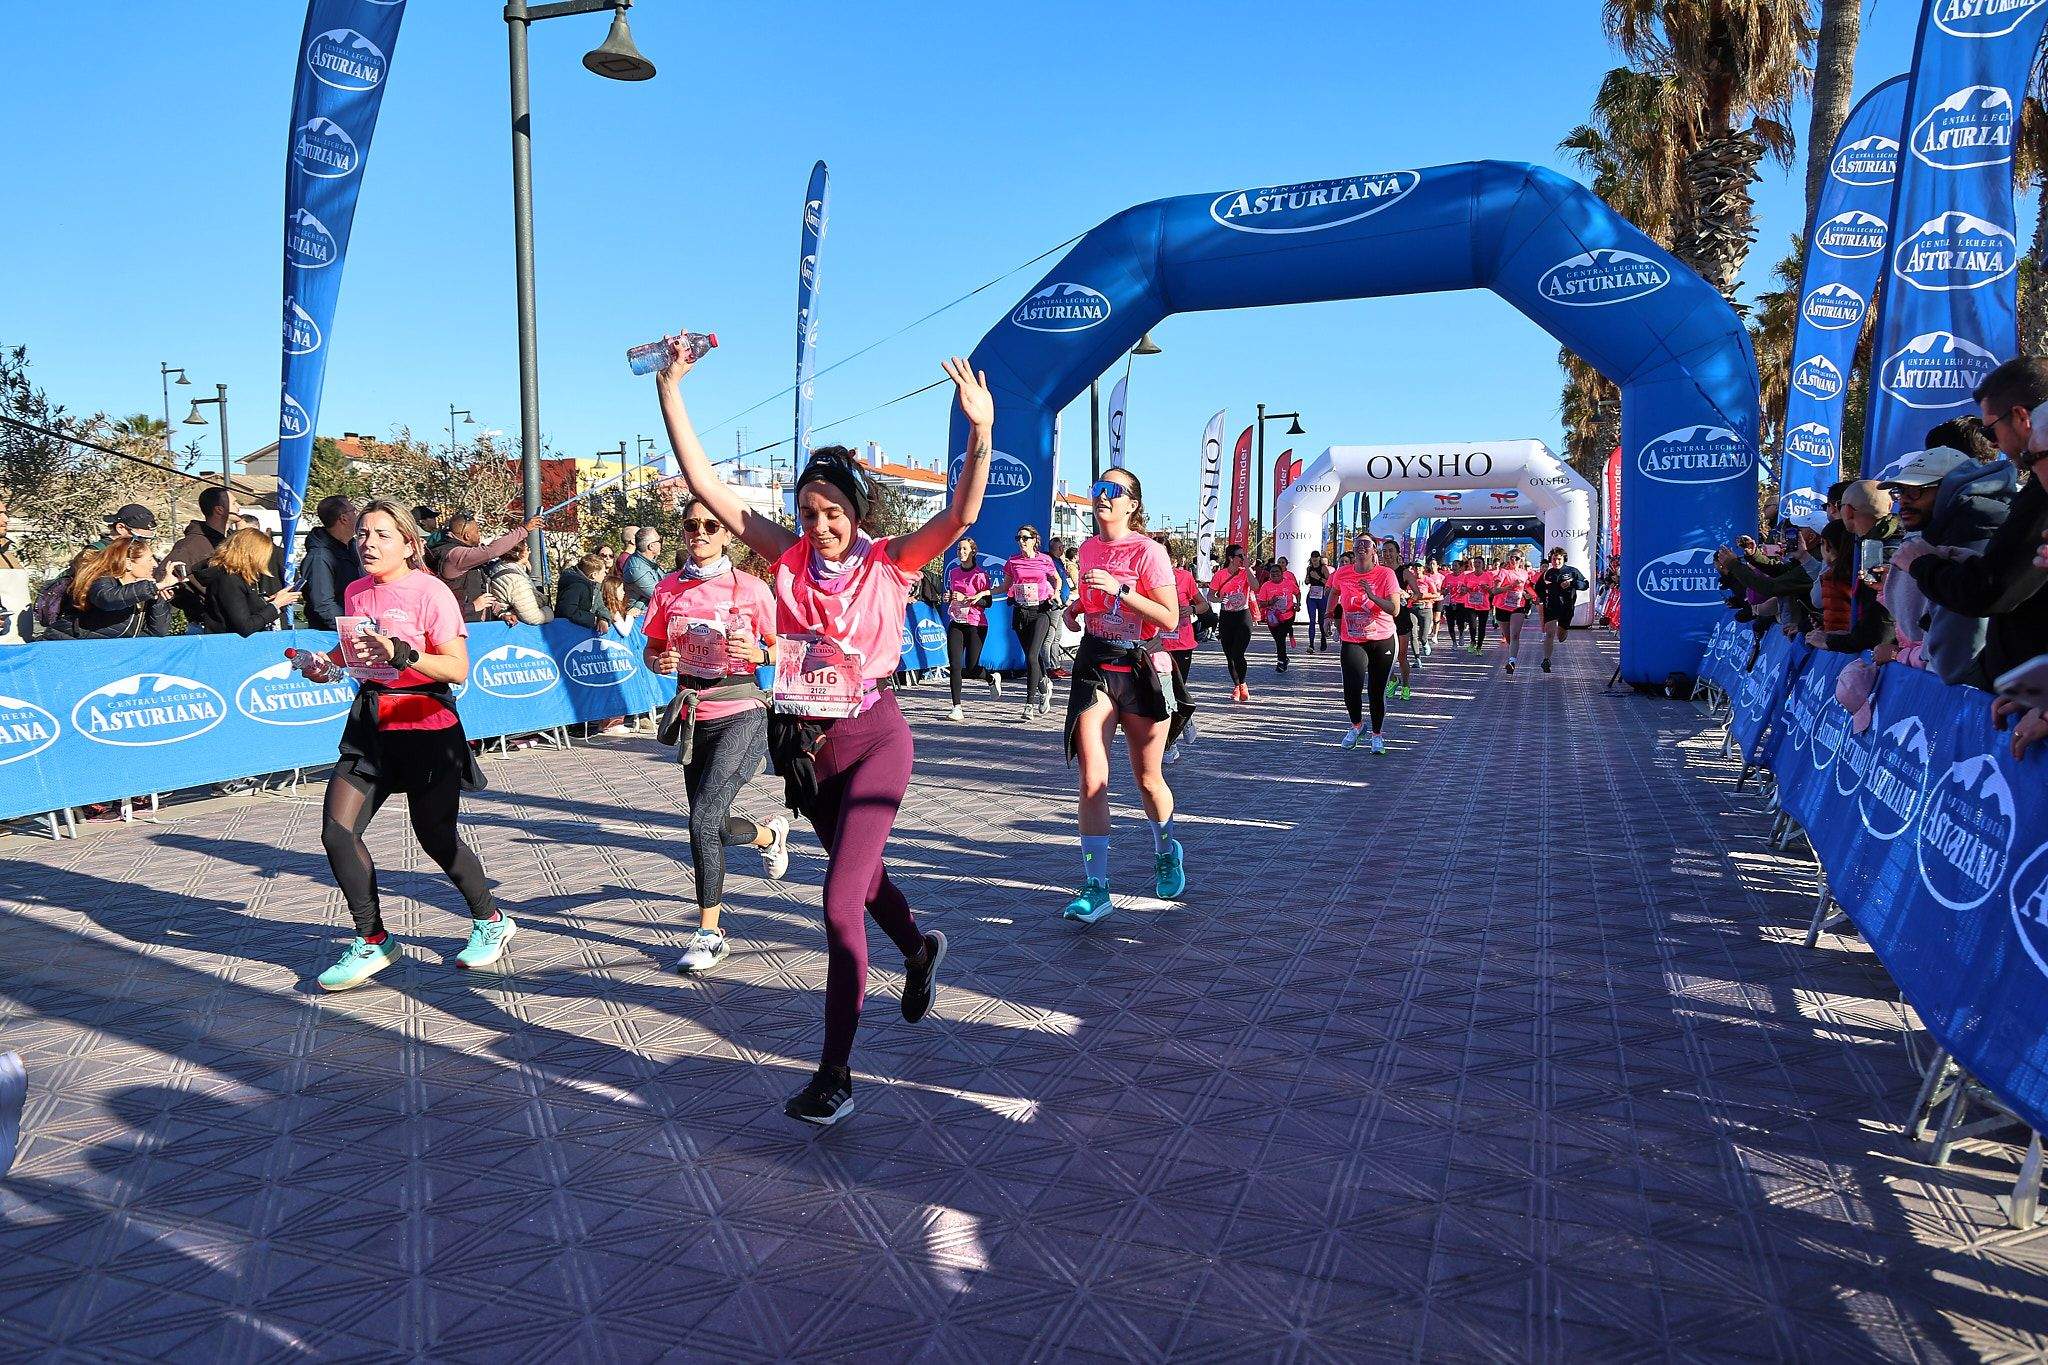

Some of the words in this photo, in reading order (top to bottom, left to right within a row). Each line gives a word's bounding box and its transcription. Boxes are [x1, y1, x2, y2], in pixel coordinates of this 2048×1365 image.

[311, 43, 379, 82] ASTURIANA
[1835, 155, 1897, 174] ASTURIAN
[1223, 177, 1402, 219] ASTURIANA
[1820, 227, 1883, 248] ASTURIANA
[1566, 268, 1610, 279] CENTRAL
[1613, 264, 1655, 272] LECHERA
[1548, 271, 1662, 297] ASTURIANA
[1017, 304, 1103, 322] ASTURIANA
[1806, 297, 1858, 321] ASTURIANA
[1662, 444, 1706, 454] CENTRAL
[1366, 451, 1493, 480] OYSHO
[1645, 449, 1748, 472] ASTURIANA
[1295, 484, 1331, 493] OYSHO
[1529, 477, 1570, 487] OYSHO
[1644, 570, 1723, 592] ASTURI
[1661, 567, 1704, 576] CENTRAL
[688, 643, 709, 656] 016
[482, 667, 556, 687] ASTURIANA
[572, 658, 635, 677] ASTURIANA
[265, 681, 306, 692] CENTRAL
[804, 671, 837, 685] 016
[107, 695, 157, 709] CENTRAL
[160, 691, 208, 703] LECHERA
[250, 686, 355, 713] ASTURIANA
[89, 700, 219, 734] ASTURIANA
[1921, 789, 1999, 890] ASTURIANA
